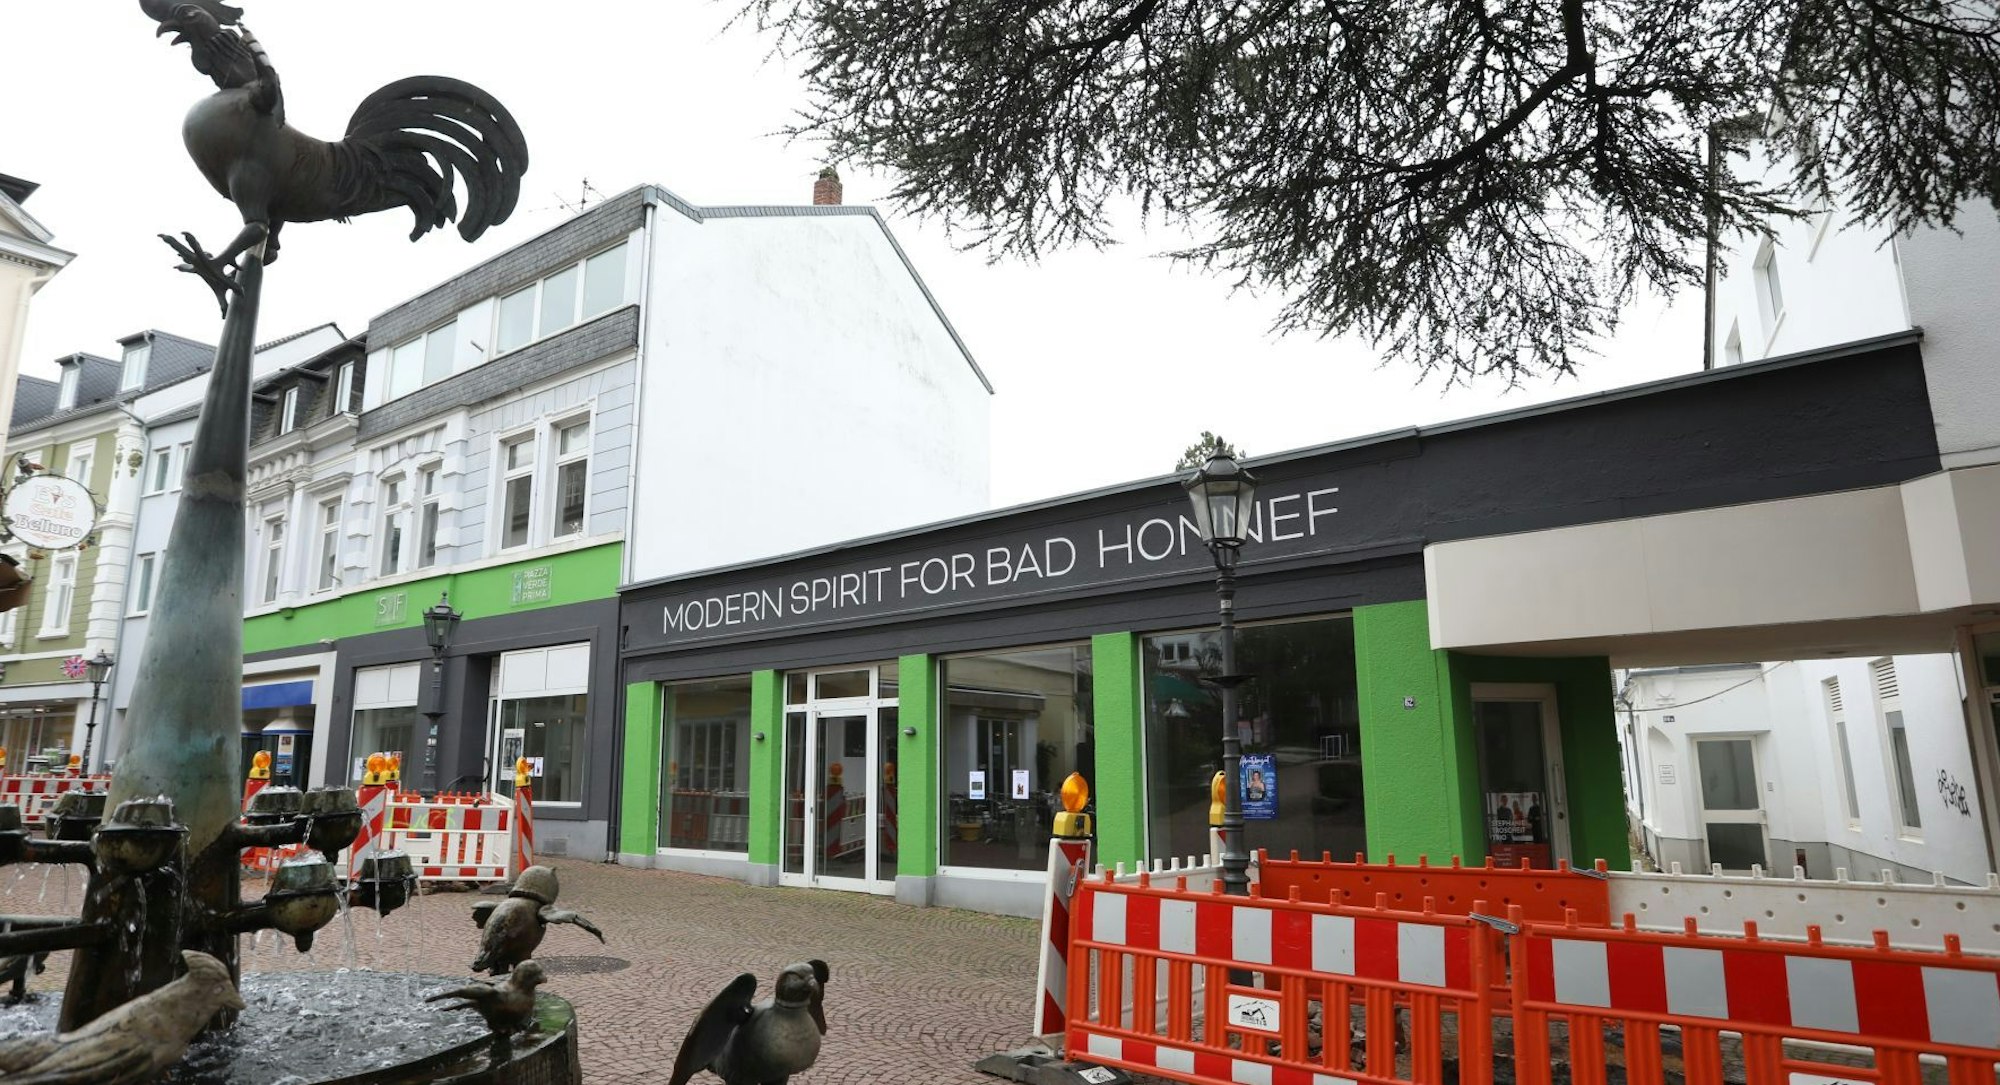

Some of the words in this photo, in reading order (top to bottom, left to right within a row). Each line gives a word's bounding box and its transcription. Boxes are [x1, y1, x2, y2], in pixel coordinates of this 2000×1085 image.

[14, 513, 83, 538] Belluno
[523, 567, 548, 579] PIAZZA
[523, 578, 548, 590] VERDE
[663, 586, 783, 635] MODERN
[790, 566, 892, 615] SPIRIT
[900, 552, 976, 599] FOR
[987, 537, 1077, 587] BAD
[522, 589, 548, 601] PRIMA
